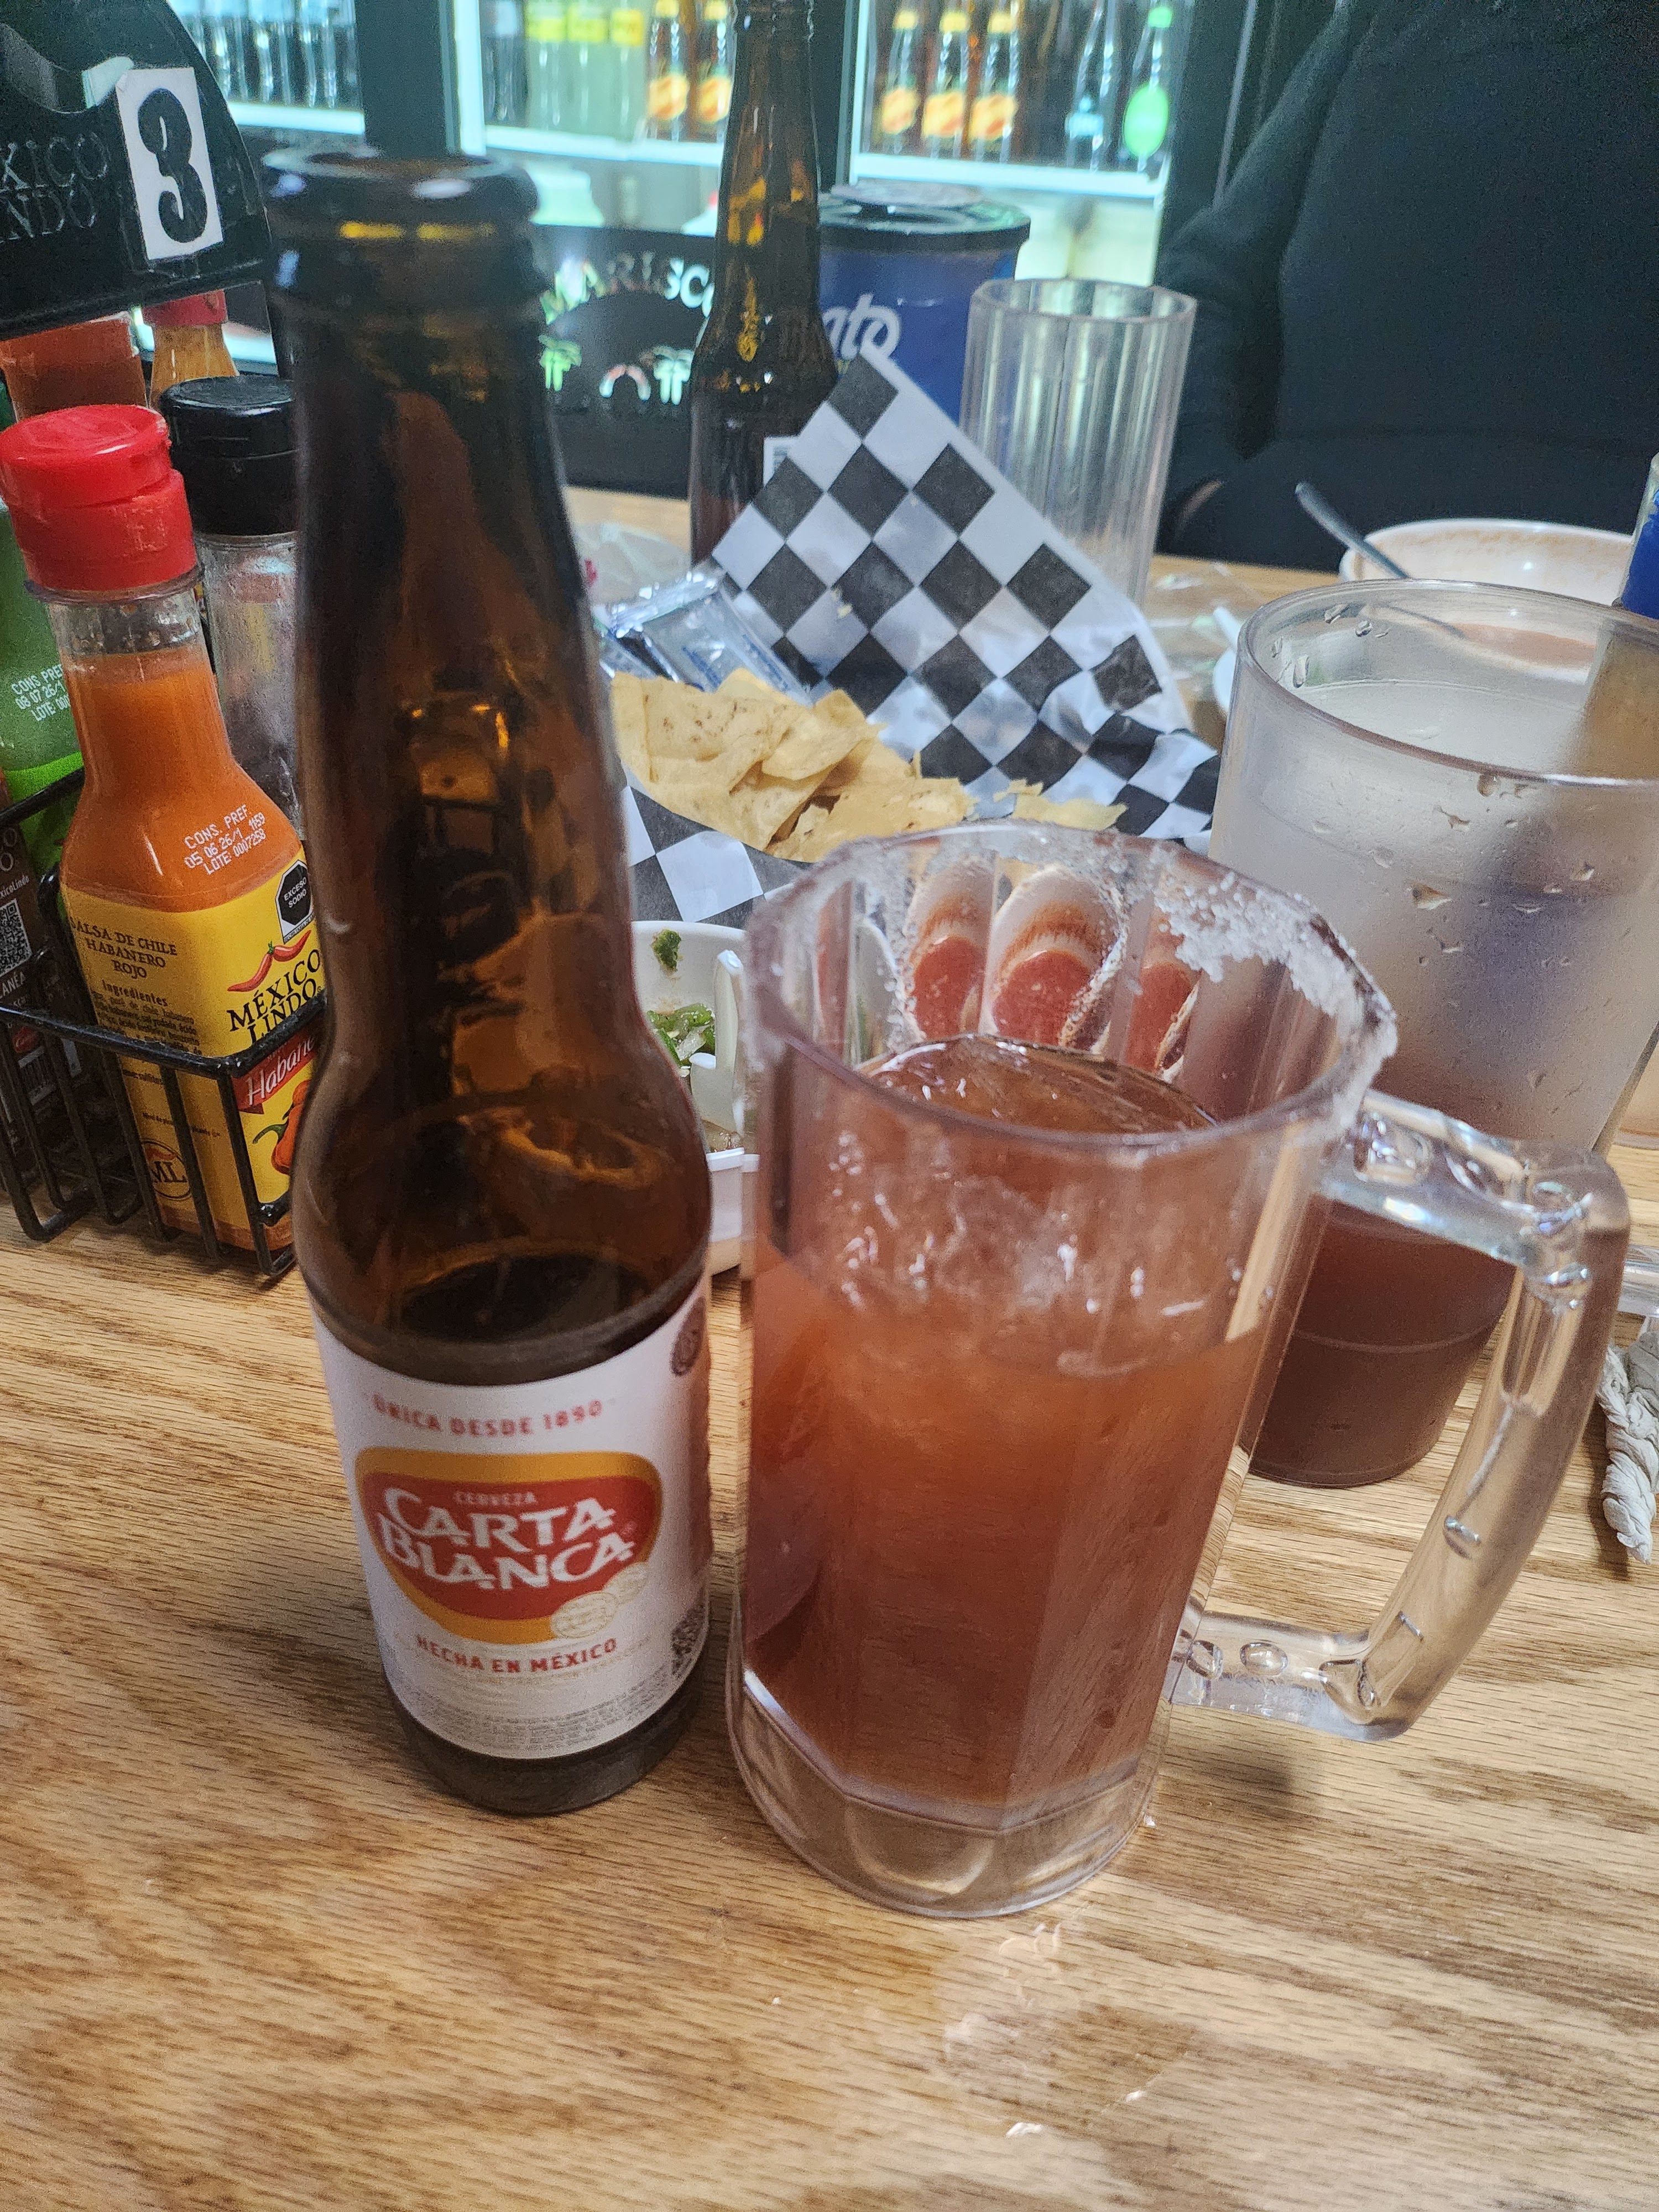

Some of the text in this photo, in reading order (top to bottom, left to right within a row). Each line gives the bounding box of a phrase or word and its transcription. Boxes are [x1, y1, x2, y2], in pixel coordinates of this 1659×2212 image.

[138, 88, 208, 243] 3
[29, 689, 42, 703] 07
[184, 851, 203, 868] 05
[204, 842, 218, 858] 06
[219, 827, 243, 849] 26/1
[232, 828, 266, 857] 0007258
[284, 877, 307, 901] EXCESO
[288, 889, 307, 908] SODIO
[85, 938, 166, 968] HABANERO
[114, 932, 135, 946] DE
[138, 938, 178, 956] CHILE
[111, 959, 147, 979] ROJO
[102, 979, 168, 1007] Ingredientes
[226, 949, 321, 1031] MÉXICO
[247, 978, 317, 1043] LINDO
[450, 1416, 534, 1436] DESDE
[385, 1486, 617, 1553] CARTA
[376, 1512, 634, 1590] BLANCA
[416, 1634, 485, 1671] HECHA
[491, 1659, 520, 1673] EN
